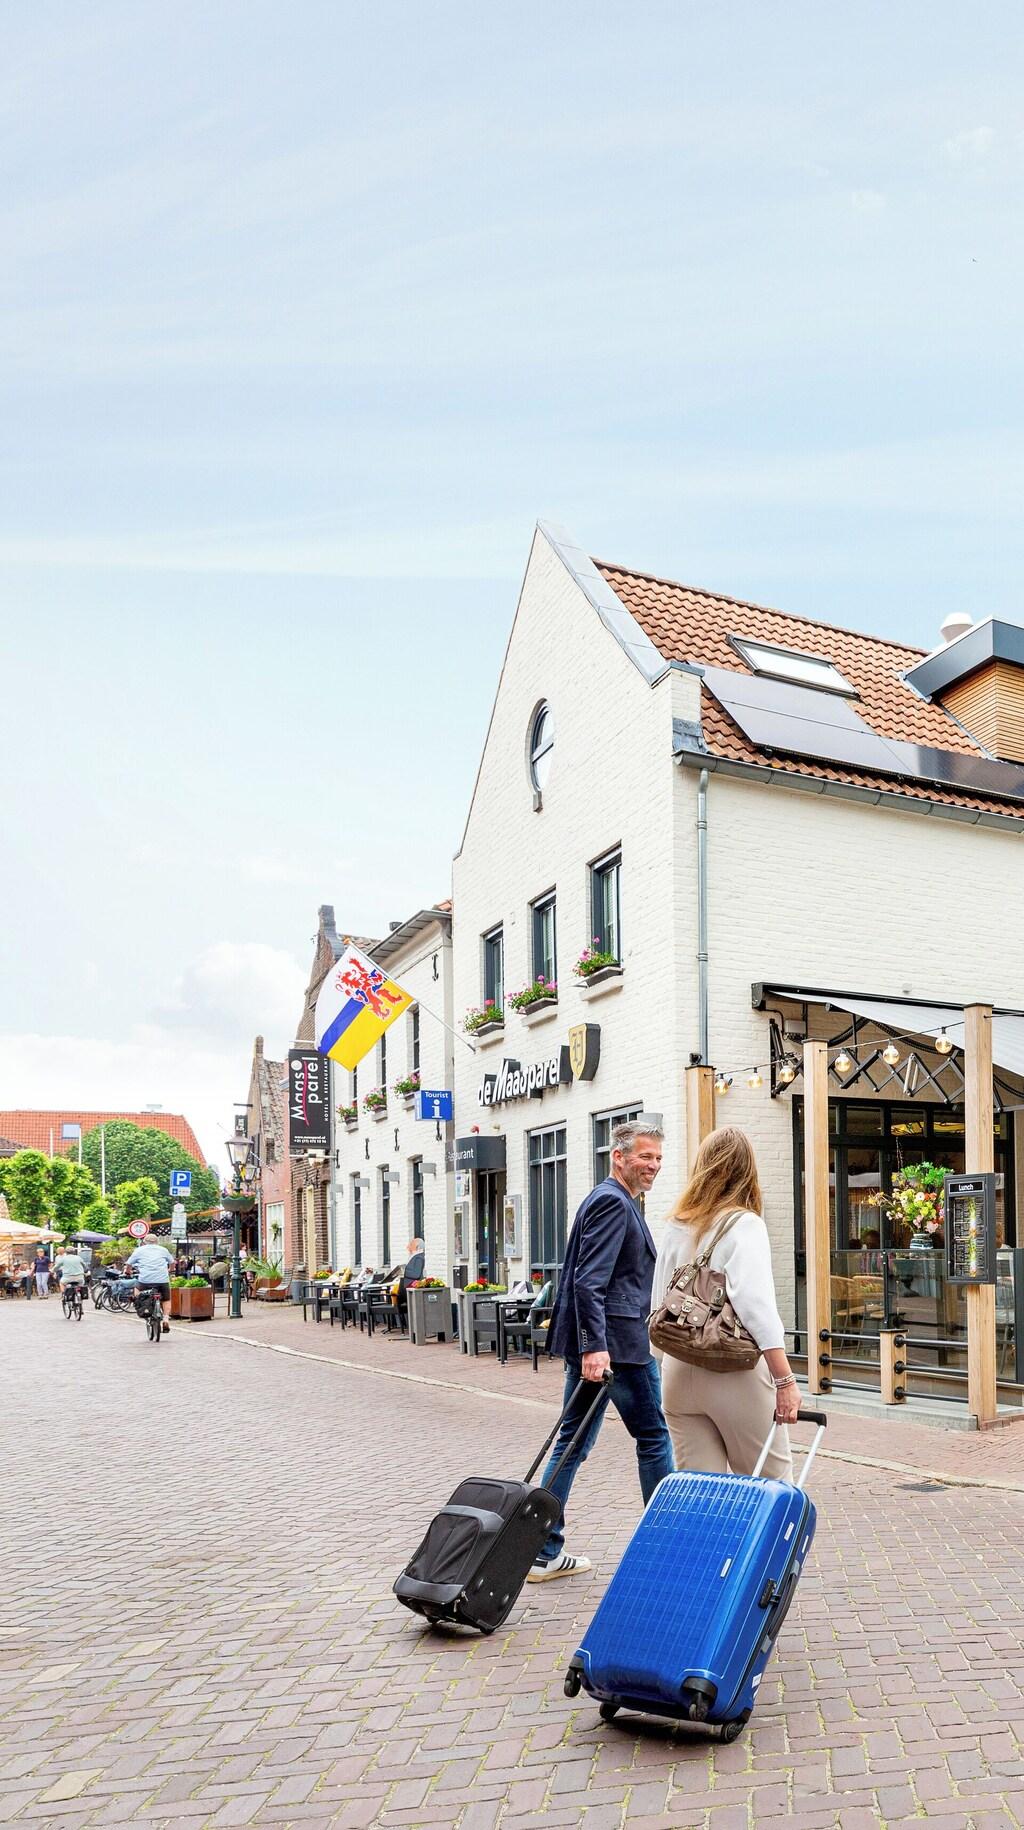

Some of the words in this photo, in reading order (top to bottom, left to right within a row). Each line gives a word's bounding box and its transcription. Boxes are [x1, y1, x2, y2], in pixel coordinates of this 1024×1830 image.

[301, 1056, 323, 1104] parel
[478, 1073, 491, 1105] de
[491, 1045, 561, 1101] Maasparel
[176, 1173, 187, 1186] P
[958, 1183, 974, 1191] Lunch
